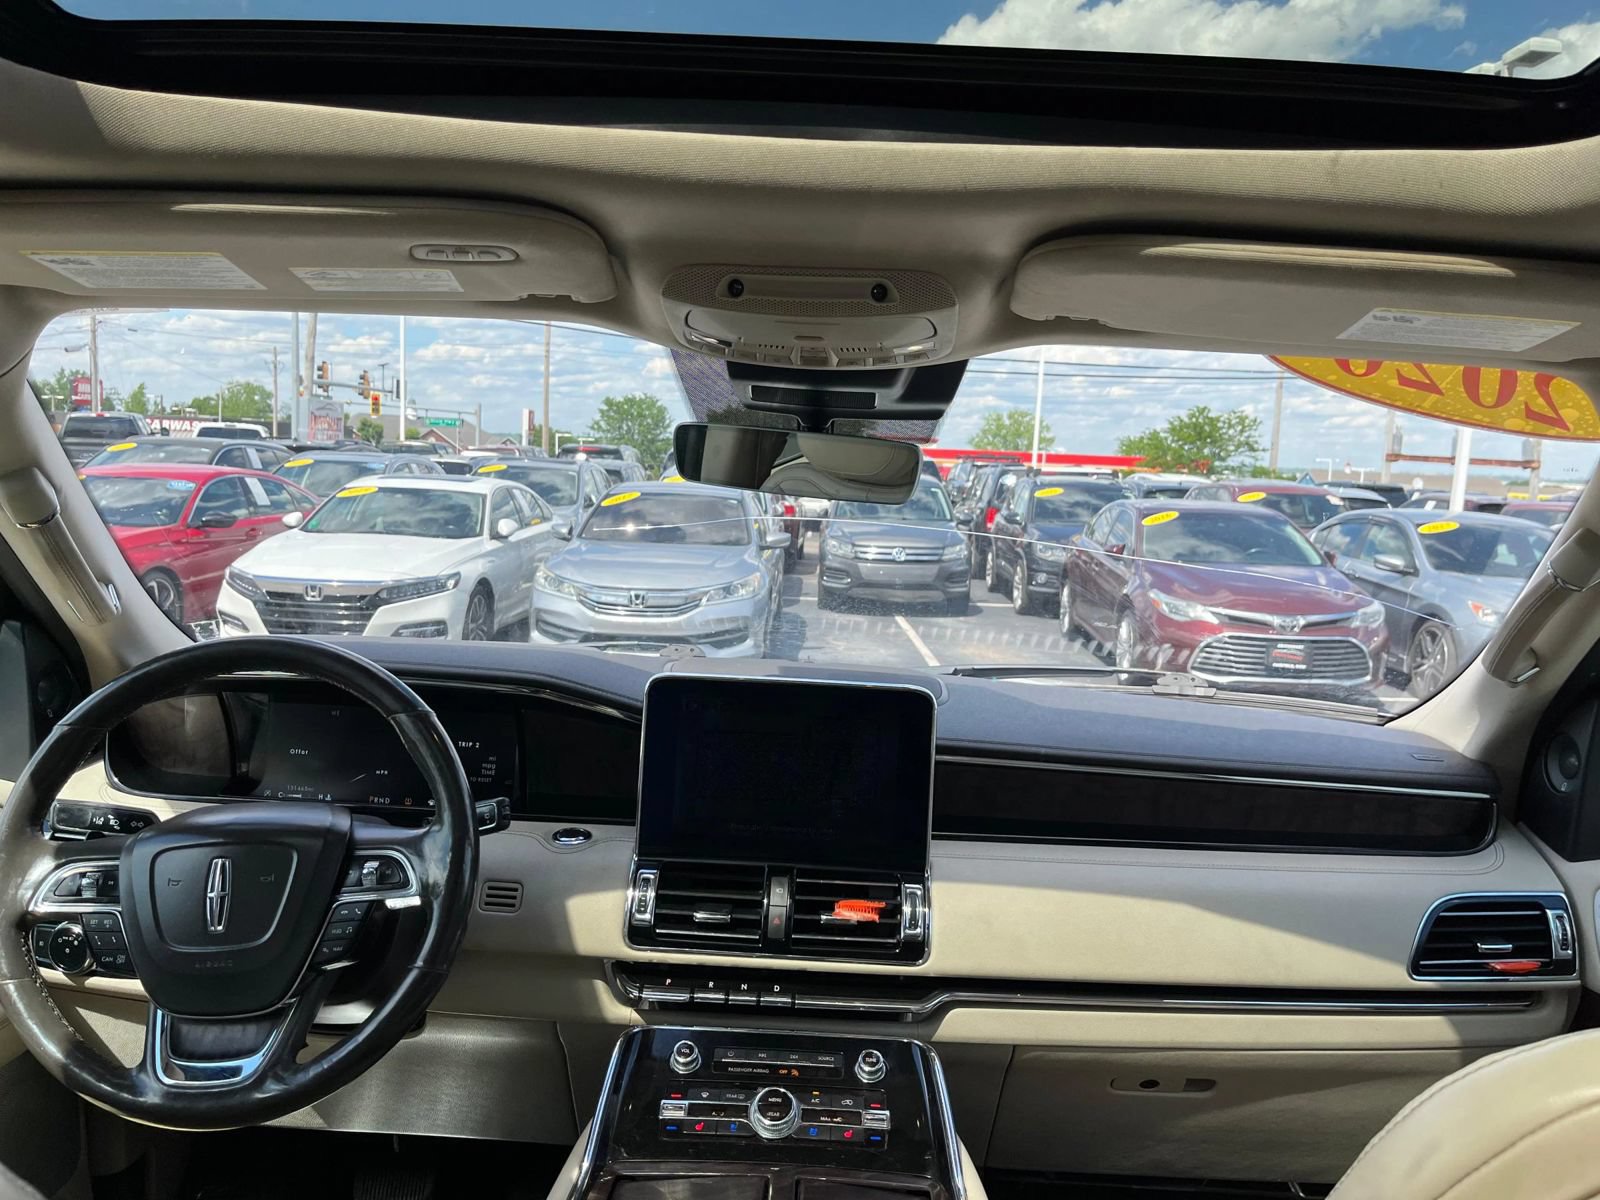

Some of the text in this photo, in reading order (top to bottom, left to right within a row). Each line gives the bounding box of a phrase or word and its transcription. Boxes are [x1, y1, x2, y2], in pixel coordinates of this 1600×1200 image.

[146, 418, 200, 431] CARWAS
[665, 978, 672, 986] P
[708, 981, 715, 989] R
[741, 983, 748, 991] N
[773, 984, 781, 992] D
